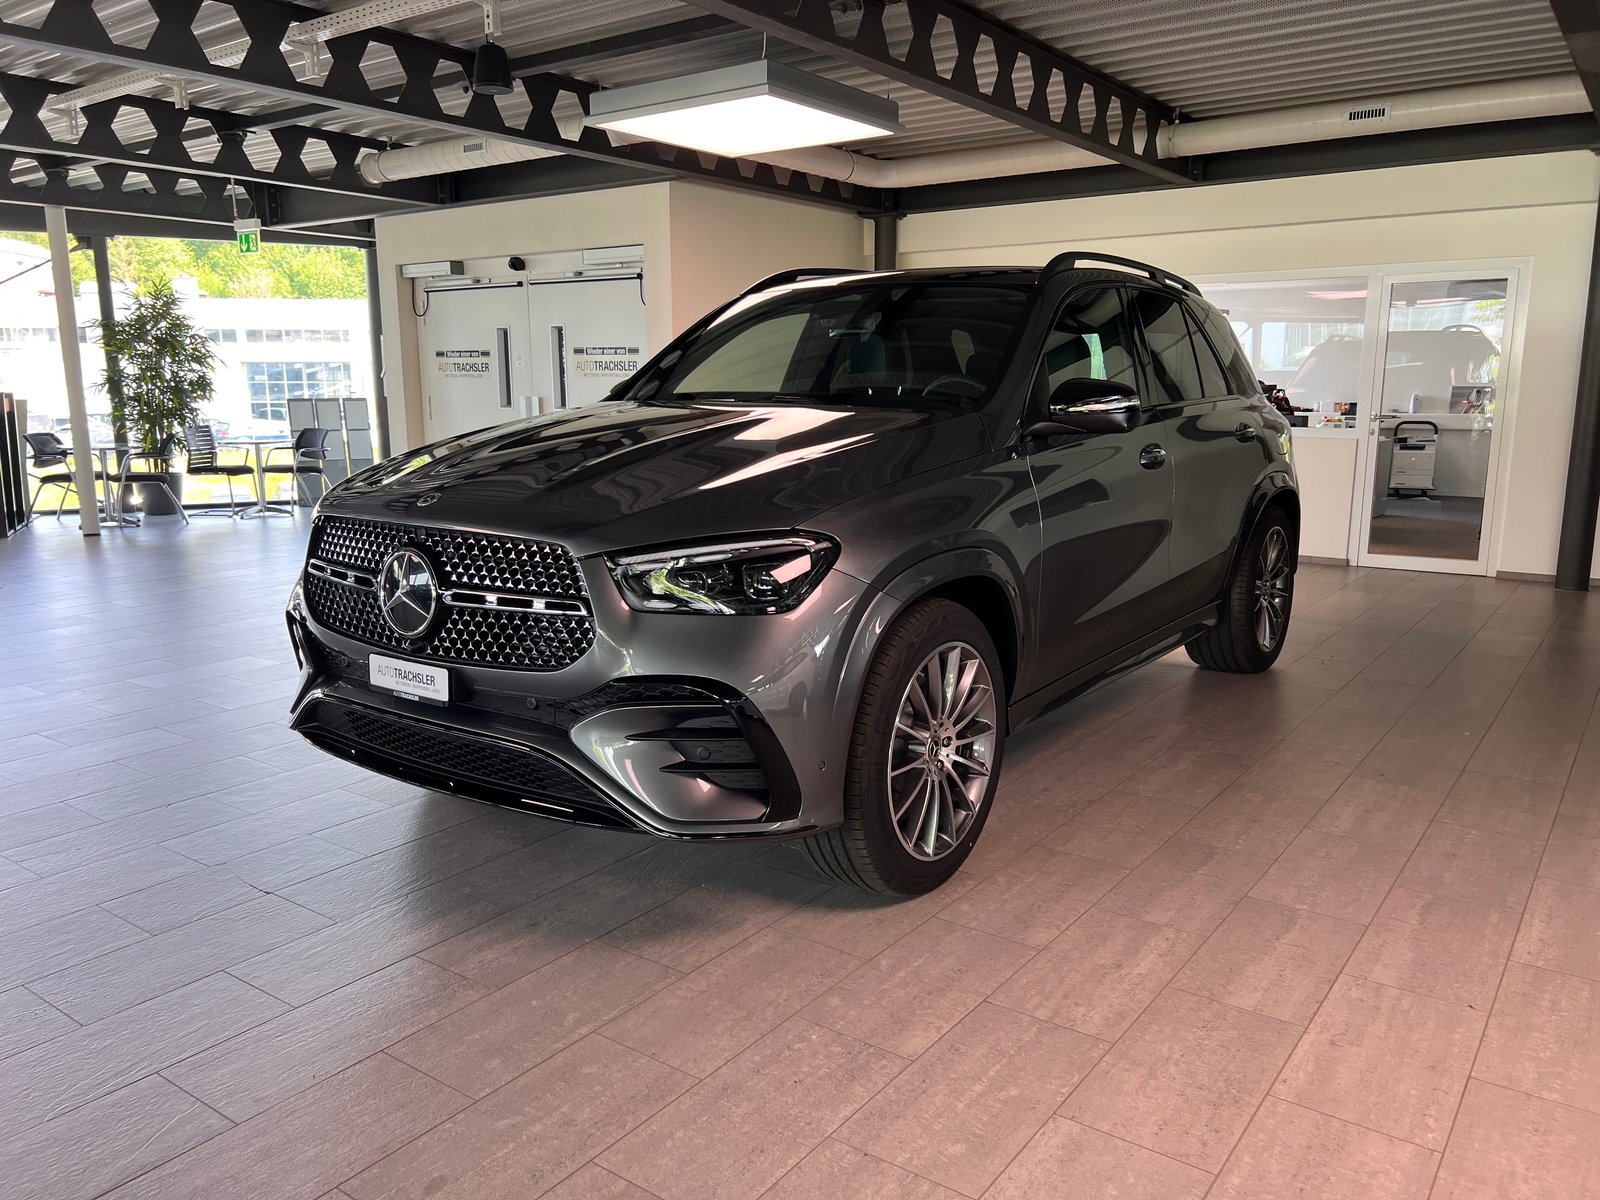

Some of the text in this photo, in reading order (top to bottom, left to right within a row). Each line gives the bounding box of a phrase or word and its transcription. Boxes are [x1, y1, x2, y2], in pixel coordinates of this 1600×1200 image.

[438, 362, 489, 373] AUTOTRACHSLER
[576, 360, 638, 371] AUTOTRACHSLER
[377, 664, 436, 687] AUTOTRACHSLER
